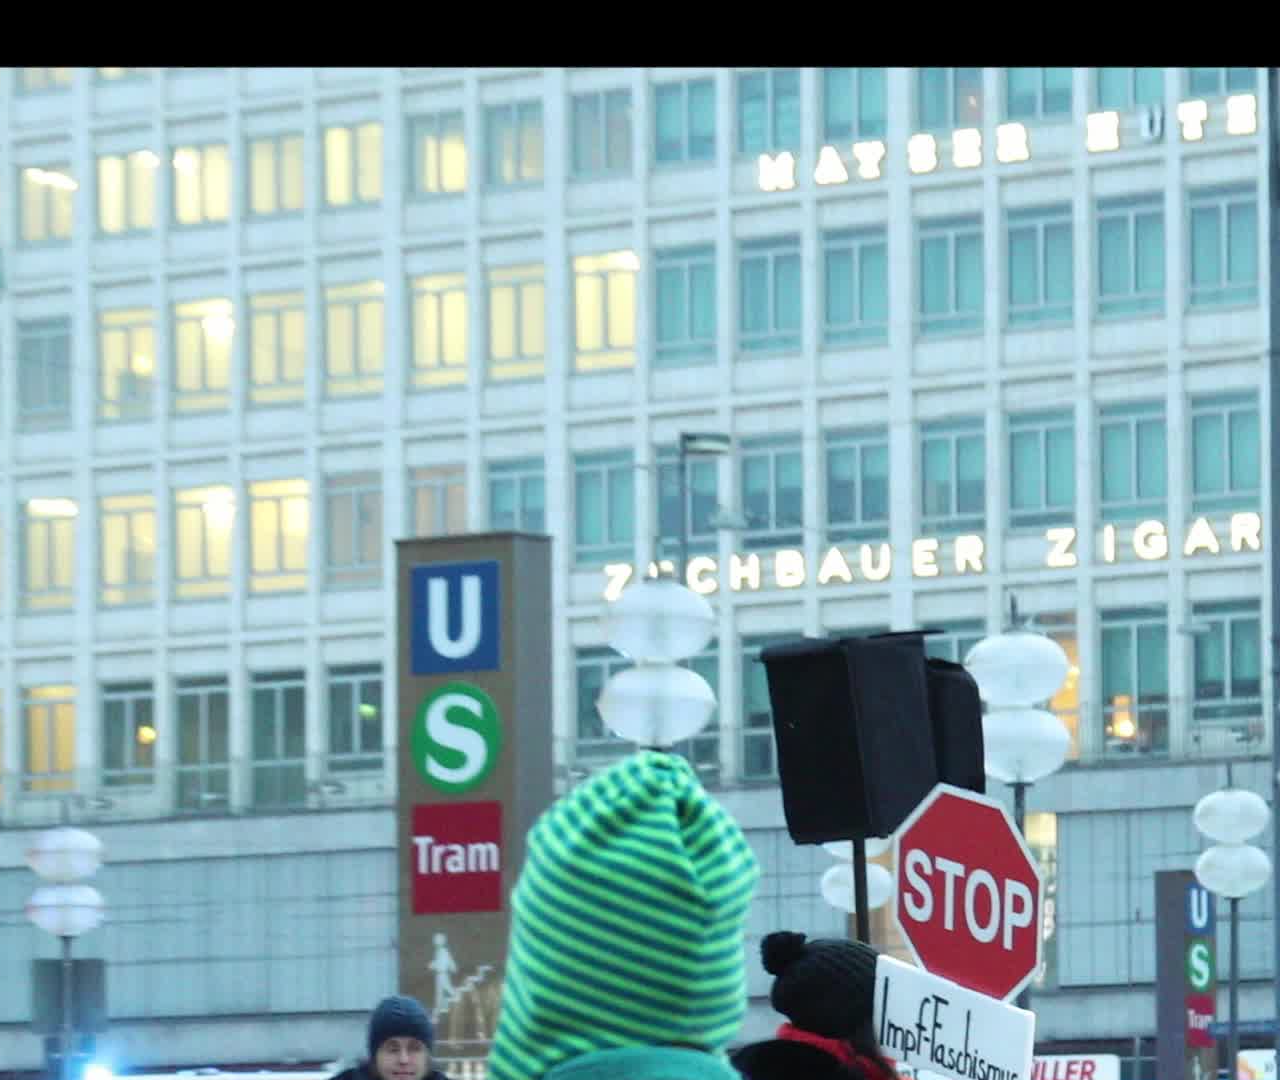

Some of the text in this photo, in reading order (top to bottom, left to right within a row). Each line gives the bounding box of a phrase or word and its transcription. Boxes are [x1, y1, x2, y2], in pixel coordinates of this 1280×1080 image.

[603, 535, 985, 601] ZCHBAUER
[427, 574, 483, 660] U
[425, 692, 489, 784] S
[413, 835, 501, 875] Tram
[903, 847, 1034, 951] STOP
[1190, 888, 1209, 929] U
[1189, 943, 1211, 988] S
